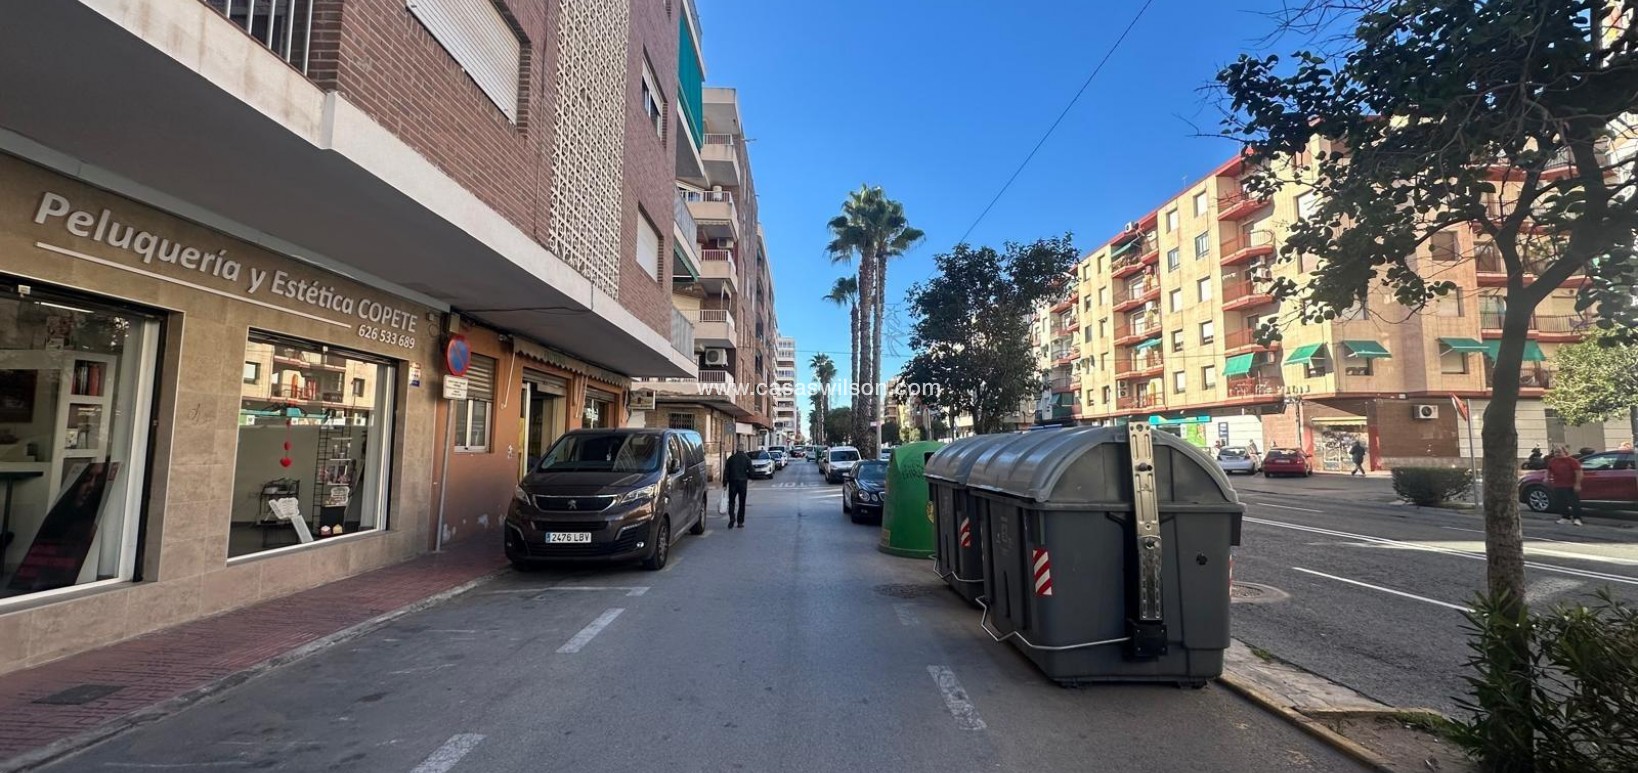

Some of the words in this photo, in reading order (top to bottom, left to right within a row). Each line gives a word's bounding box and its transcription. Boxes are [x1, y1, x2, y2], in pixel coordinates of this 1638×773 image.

[34, 191, 241, 282] Peluquería
[248, 267, 267, 293] y
[271, 270, 354, 315] Estética
[358, 298, 418, 333] COPETE
[358, 324, 378, 342] 626
[379, 329, 397, 345] 533
[398, 333, 416, 350] 689
[552, 533, 572, 542] 2476
